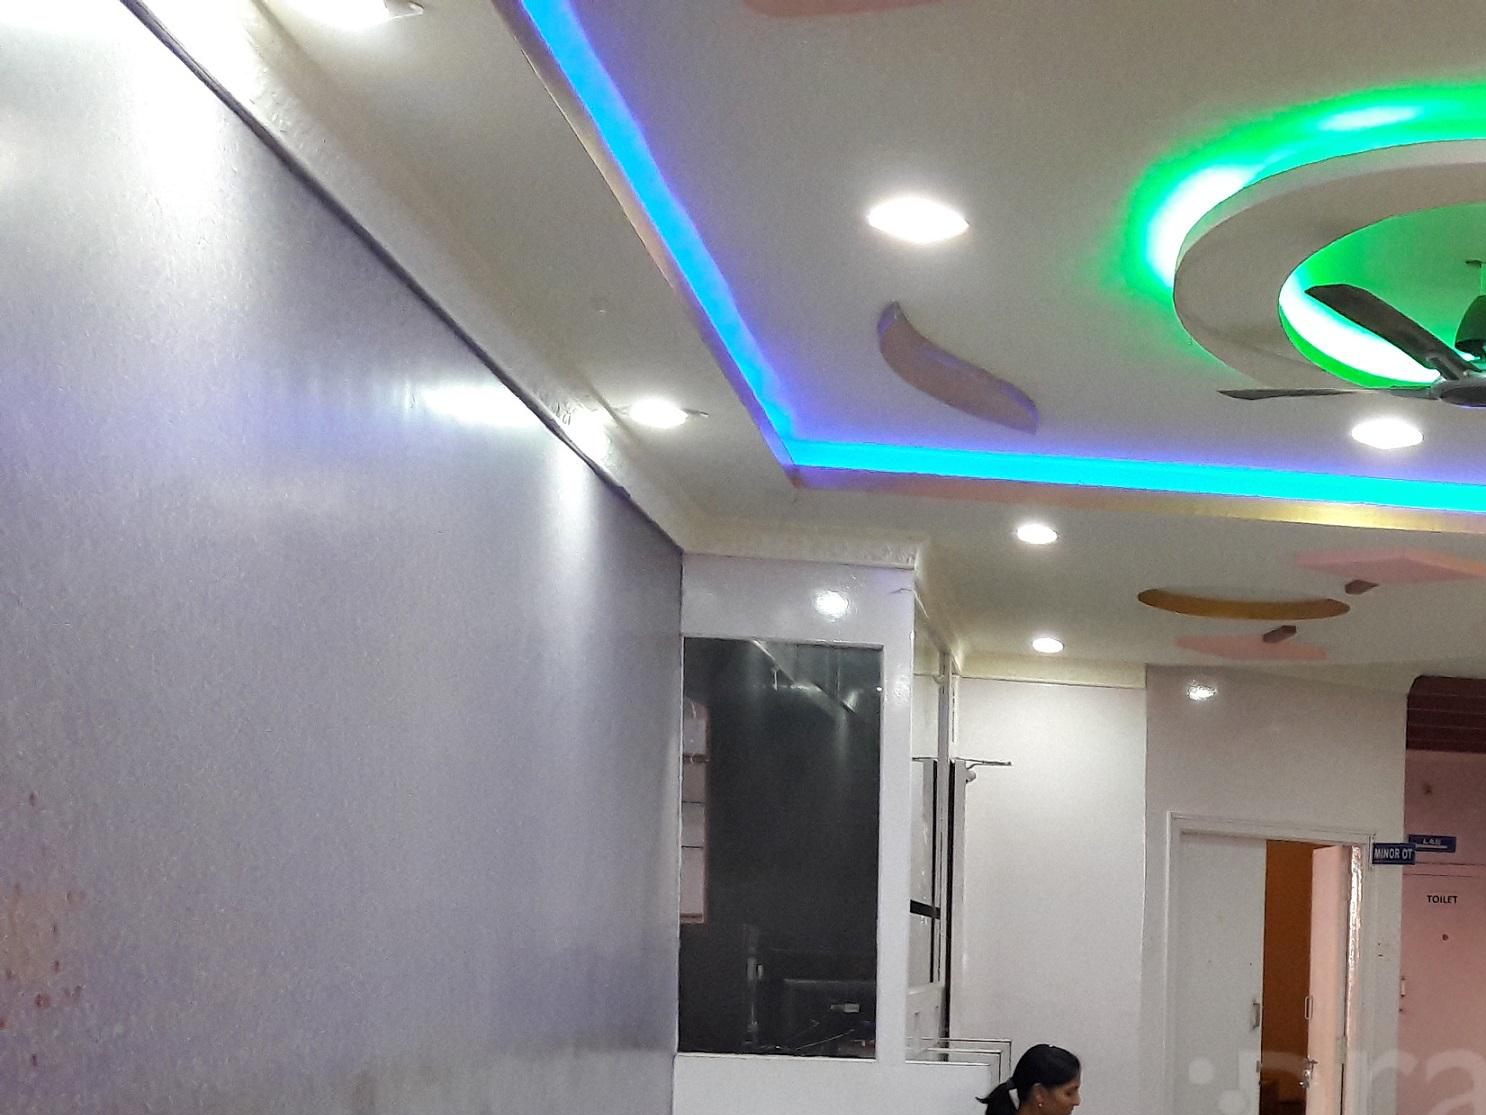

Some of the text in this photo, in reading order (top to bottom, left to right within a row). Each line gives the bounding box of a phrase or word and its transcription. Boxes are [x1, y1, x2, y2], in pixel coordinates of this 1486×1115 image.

[1373, 847, 1413, 860] MINOR OT
[1426, 894, 1458, 904] TOILET
